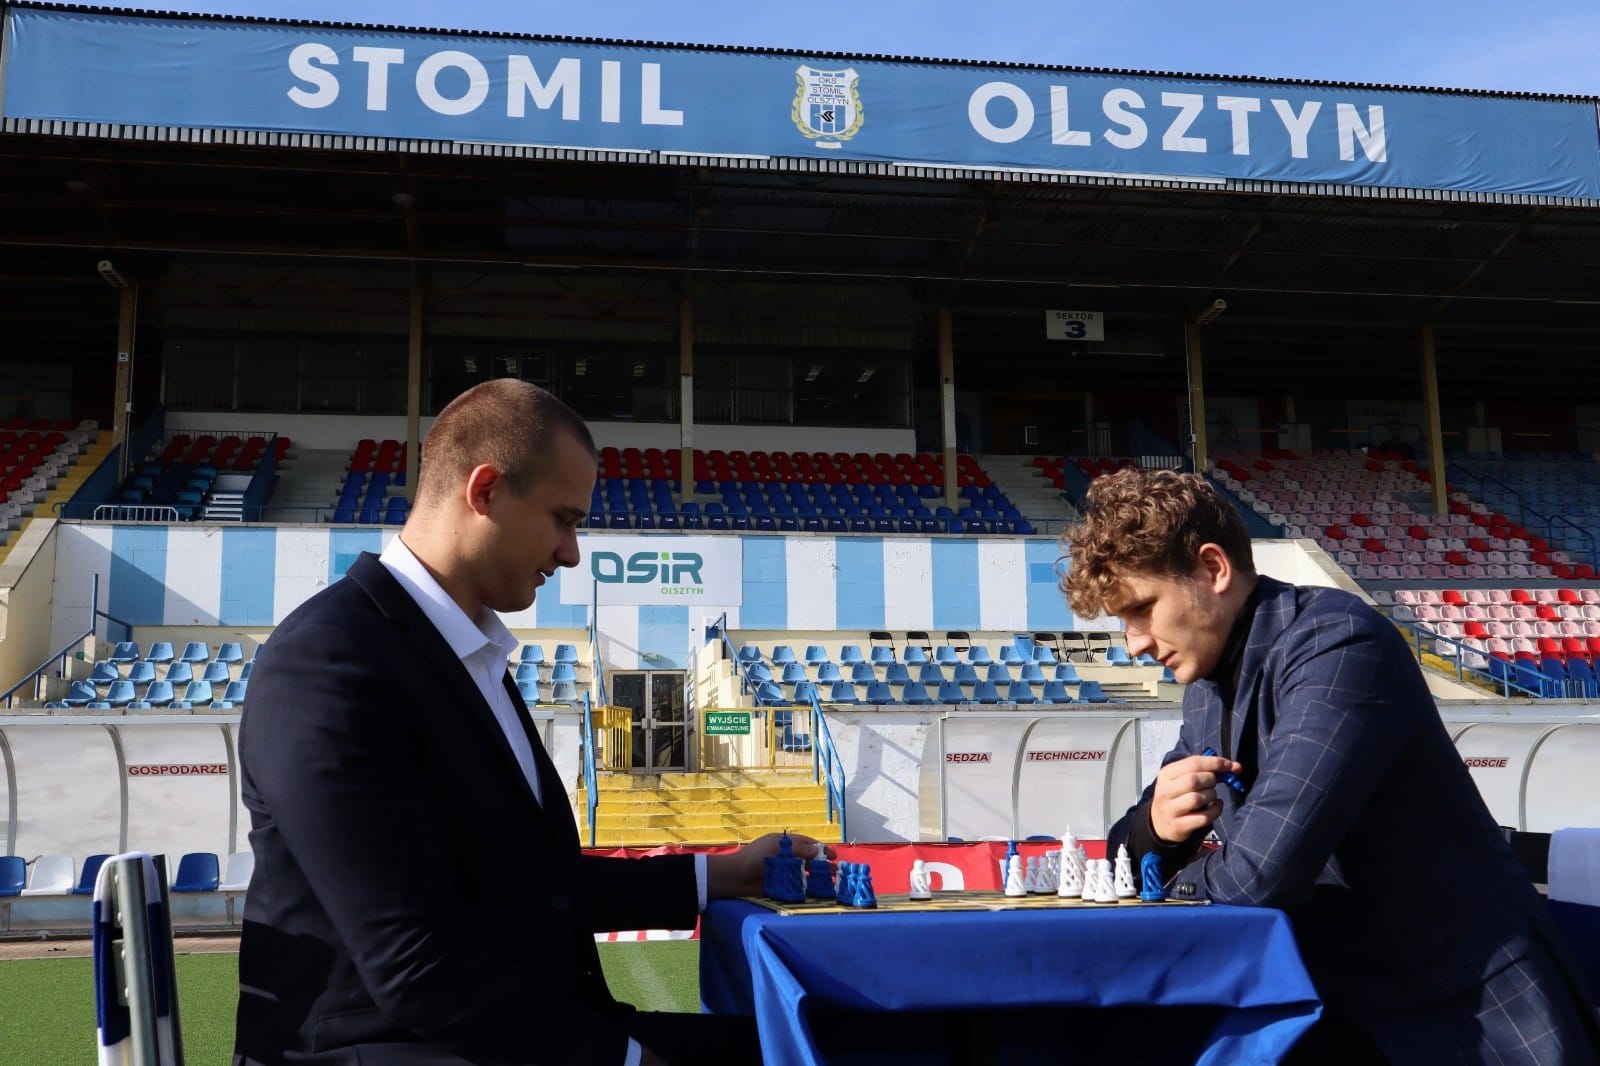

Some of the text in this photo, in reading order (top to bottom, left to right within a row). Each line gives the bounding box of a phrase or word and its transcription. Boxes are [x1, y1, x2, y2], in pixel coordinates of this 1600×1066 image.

[818, 76, 837, 85] OKS
[812, 87, 844, 95] STOMIL
[286, 42, 1388, 163] STOMIL OLSZTYN
[807, 97, 849, 105] OLSZTYN
[1055, 312, 1094, 320] SEKTOR
[1064, 320, 1086, 338] 3
[661, 587, 704, 595] OLSZTYN
[708, 715, 748, 724] WYJŚCIE
[946, 753, 989, 764] SĘDZIA
[1029, 751, 1105, 761] TECHNICZNY
[128, 764, 228, 776] GOSPODARZE
